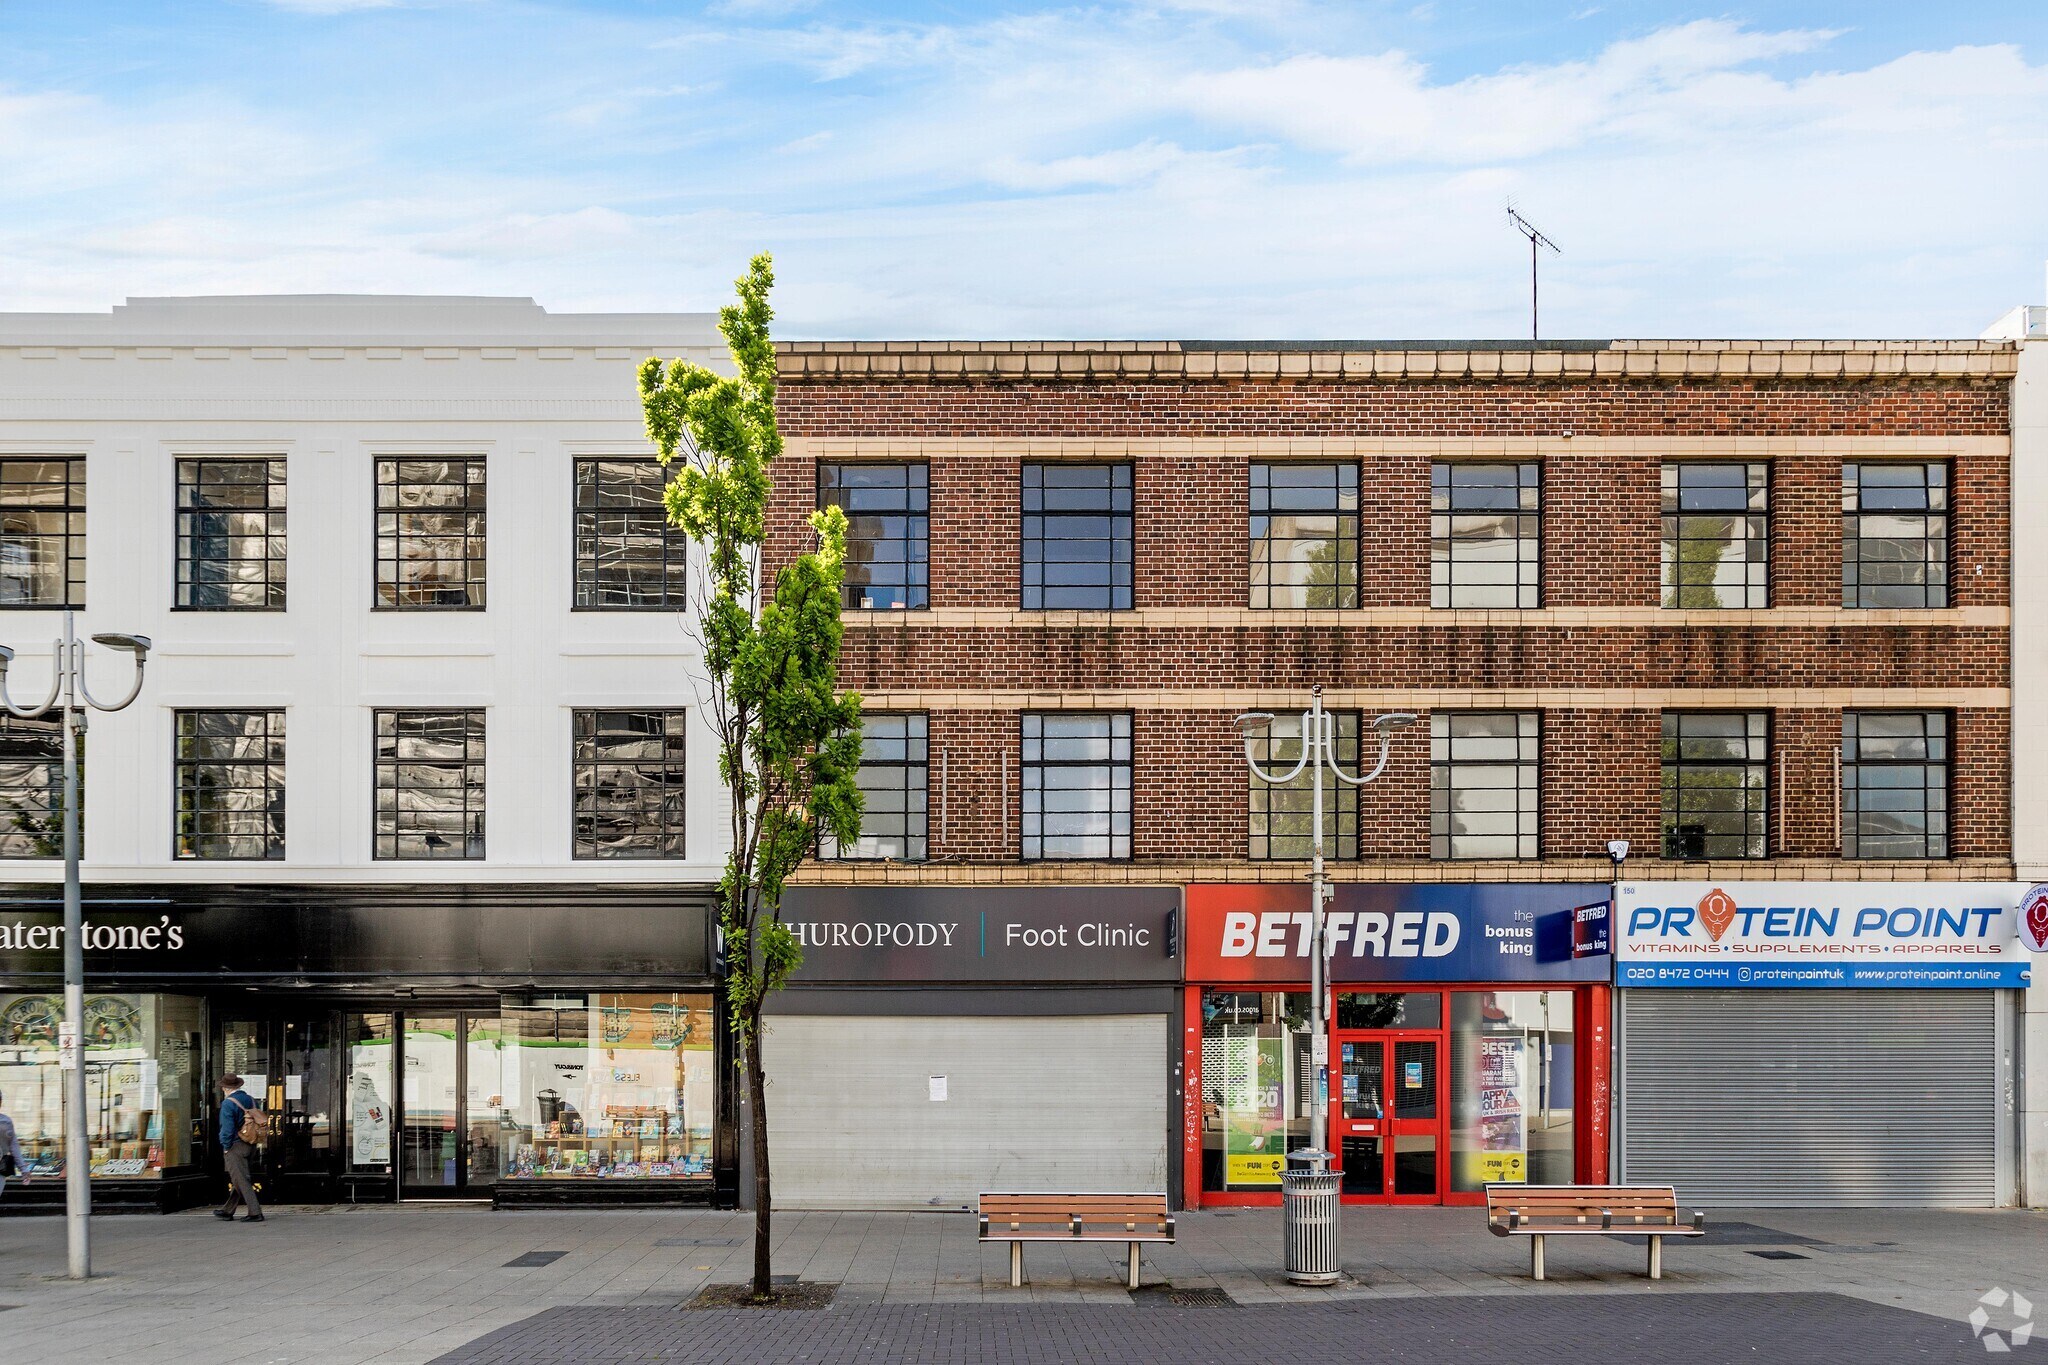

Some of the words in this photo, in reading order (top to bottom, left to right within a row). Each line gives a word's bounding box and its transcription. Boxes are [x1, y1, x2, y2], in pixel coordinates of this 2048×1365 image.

[1514, 910, 1534, 922] the
[1576, 906, 1606, 922] BETFRED
[1853, 907, 2002, 937] POINT
[0, 915, 184, 950] atertone's
[769, 922, 958, 947] HUROPODY
[1006, 923, 1068, 947] Foot
[1077, 922, 1150, 947] Clinic
[1220, 912, 1461, 957] BETFRED
[1485, 925, 1534, 938] bonus
[1499, 941, 1534, 956] king
[1576, 942, 1593, 951] bonus
[1594, 940, 1606, 950] king
[1628, 944, 1721, 953] VITAMINS
[1732, 944, 1881, 954] SUPPLEMENTS
[1893, 944, 2002, 954] APPARELS
[1627, 969, 1655, 979] 020
[1659, 969, 1690, 979] 8472
[1694, 969, 1729, 979] 0444
[1753, 968, 1844, 981] proteinpointuk
[1854, 968, 2001, 982] www.proteinpoint.online
